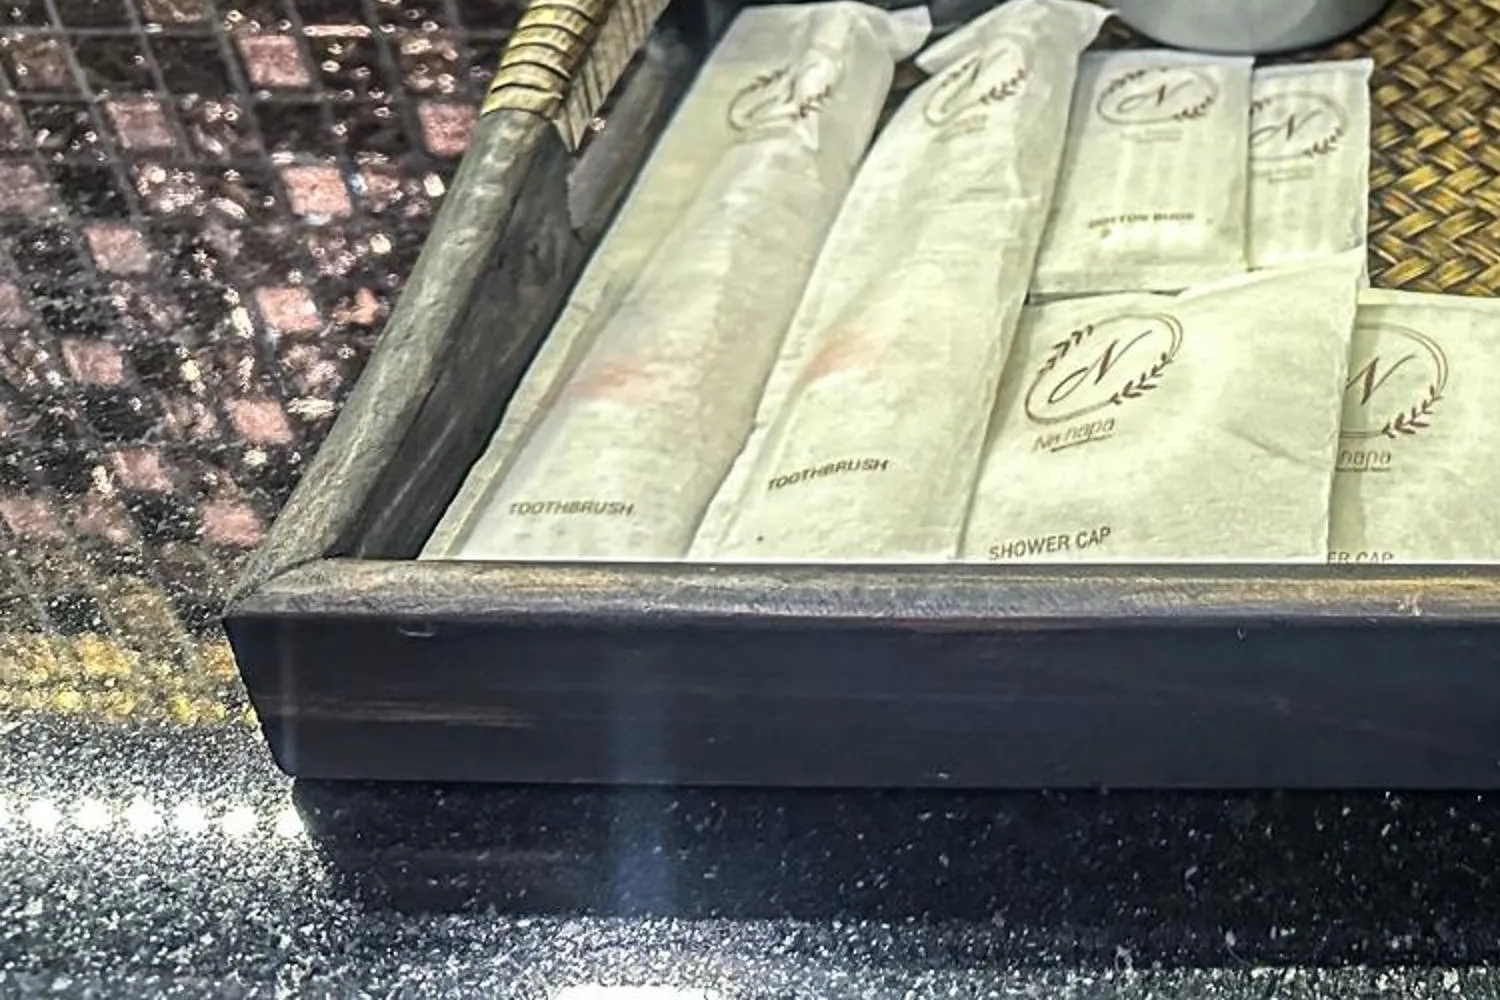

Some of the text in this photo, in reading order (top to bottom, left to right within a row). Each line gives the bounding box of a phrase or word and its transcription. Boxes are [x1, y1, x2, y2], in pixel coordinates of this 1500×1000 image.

[768, 458, 890, 492] TOOTHBRUSH
[508, 499, 636, 517] TOOTHBRUSH
[988, 525, 1112, 560] SHOWER CAP
